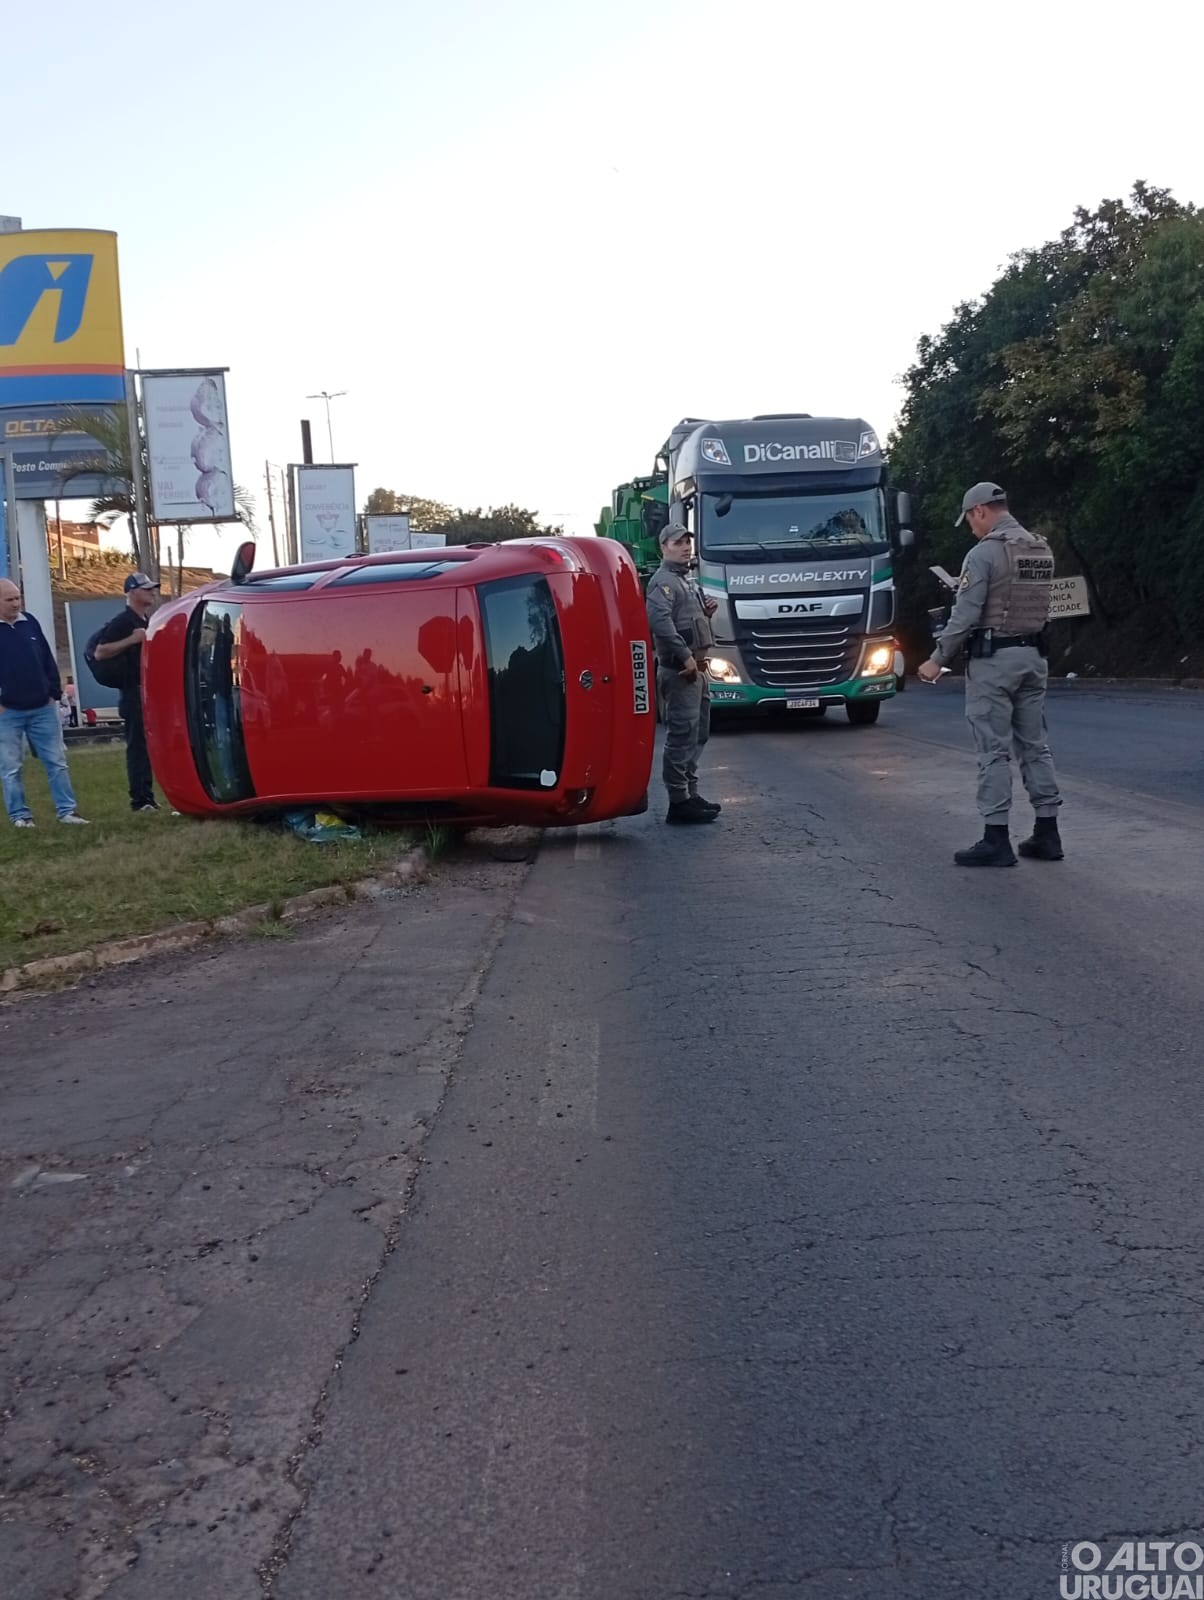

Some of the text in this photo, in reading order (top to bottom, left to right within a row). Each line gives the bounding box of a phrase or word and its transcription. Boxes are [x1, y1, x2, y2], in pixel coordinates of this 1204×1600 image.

[743, 440, 835, 463] DiCanalli
[11, 461, 36, 472] Posto
[1018, 559, 1053, 569] BRIGADA
[730, 570, 868, 585] HIGH COMPLEXITY
[778, 603, 823, 613] DAF
